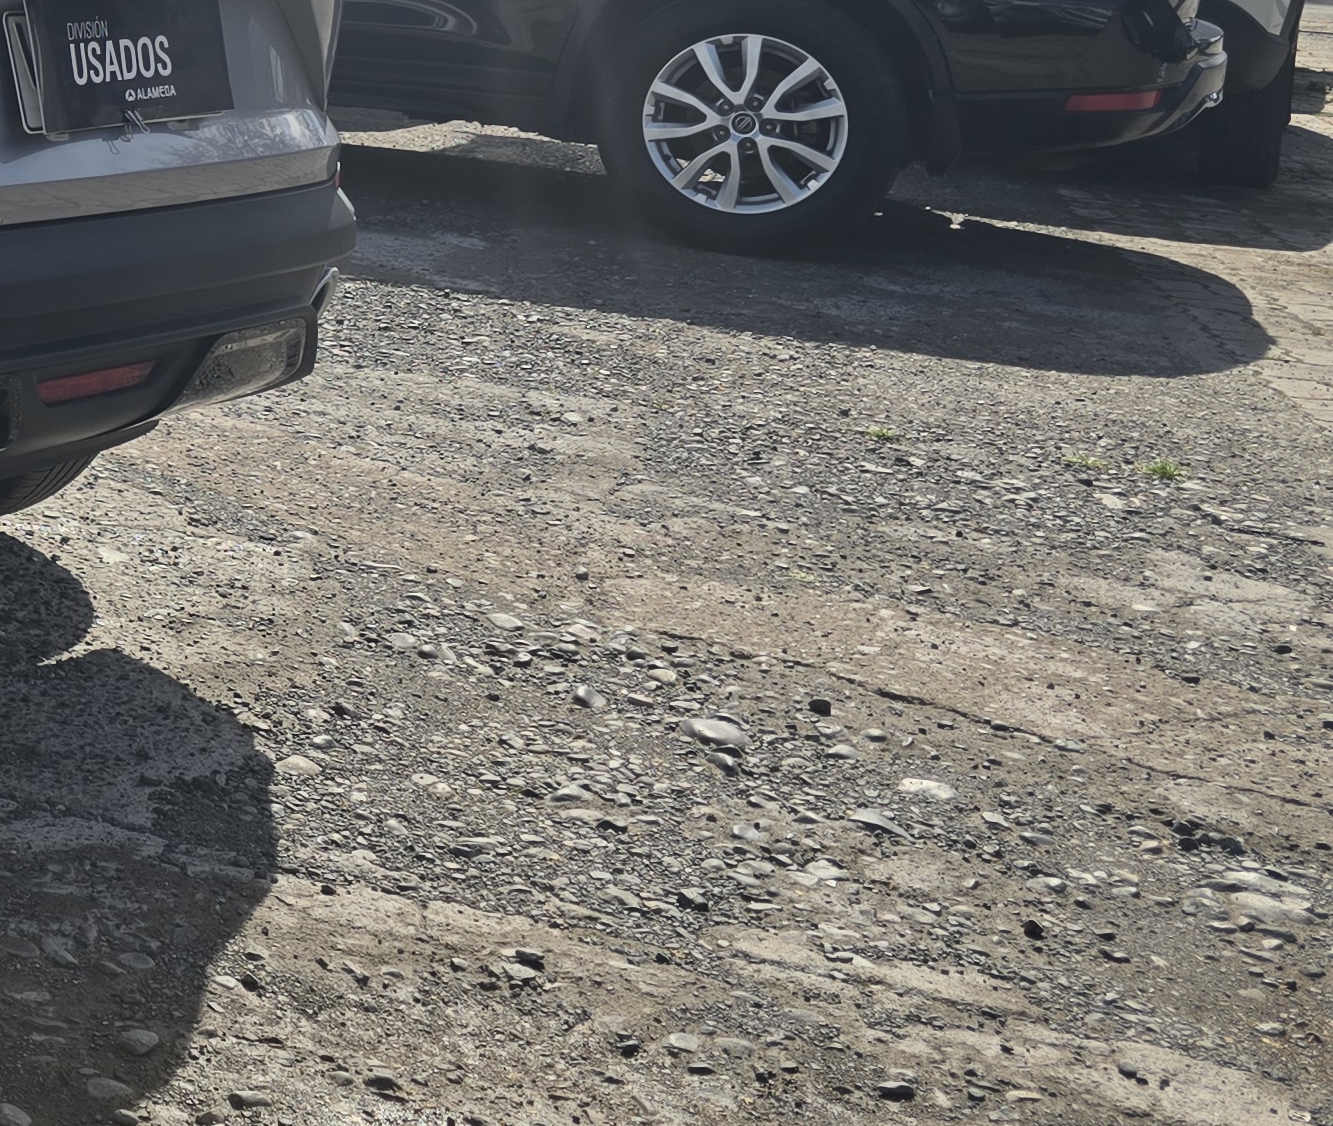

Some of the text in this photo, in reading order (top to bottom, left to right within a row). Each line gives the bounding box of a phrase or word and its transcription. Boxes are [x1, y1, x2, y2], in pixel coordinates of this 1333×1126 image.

[67, 15, 109, 41] DIVISIÓN
[69, 34, 172, 86] USADOS
[137, 84, 177, 101] ALAMEDA
